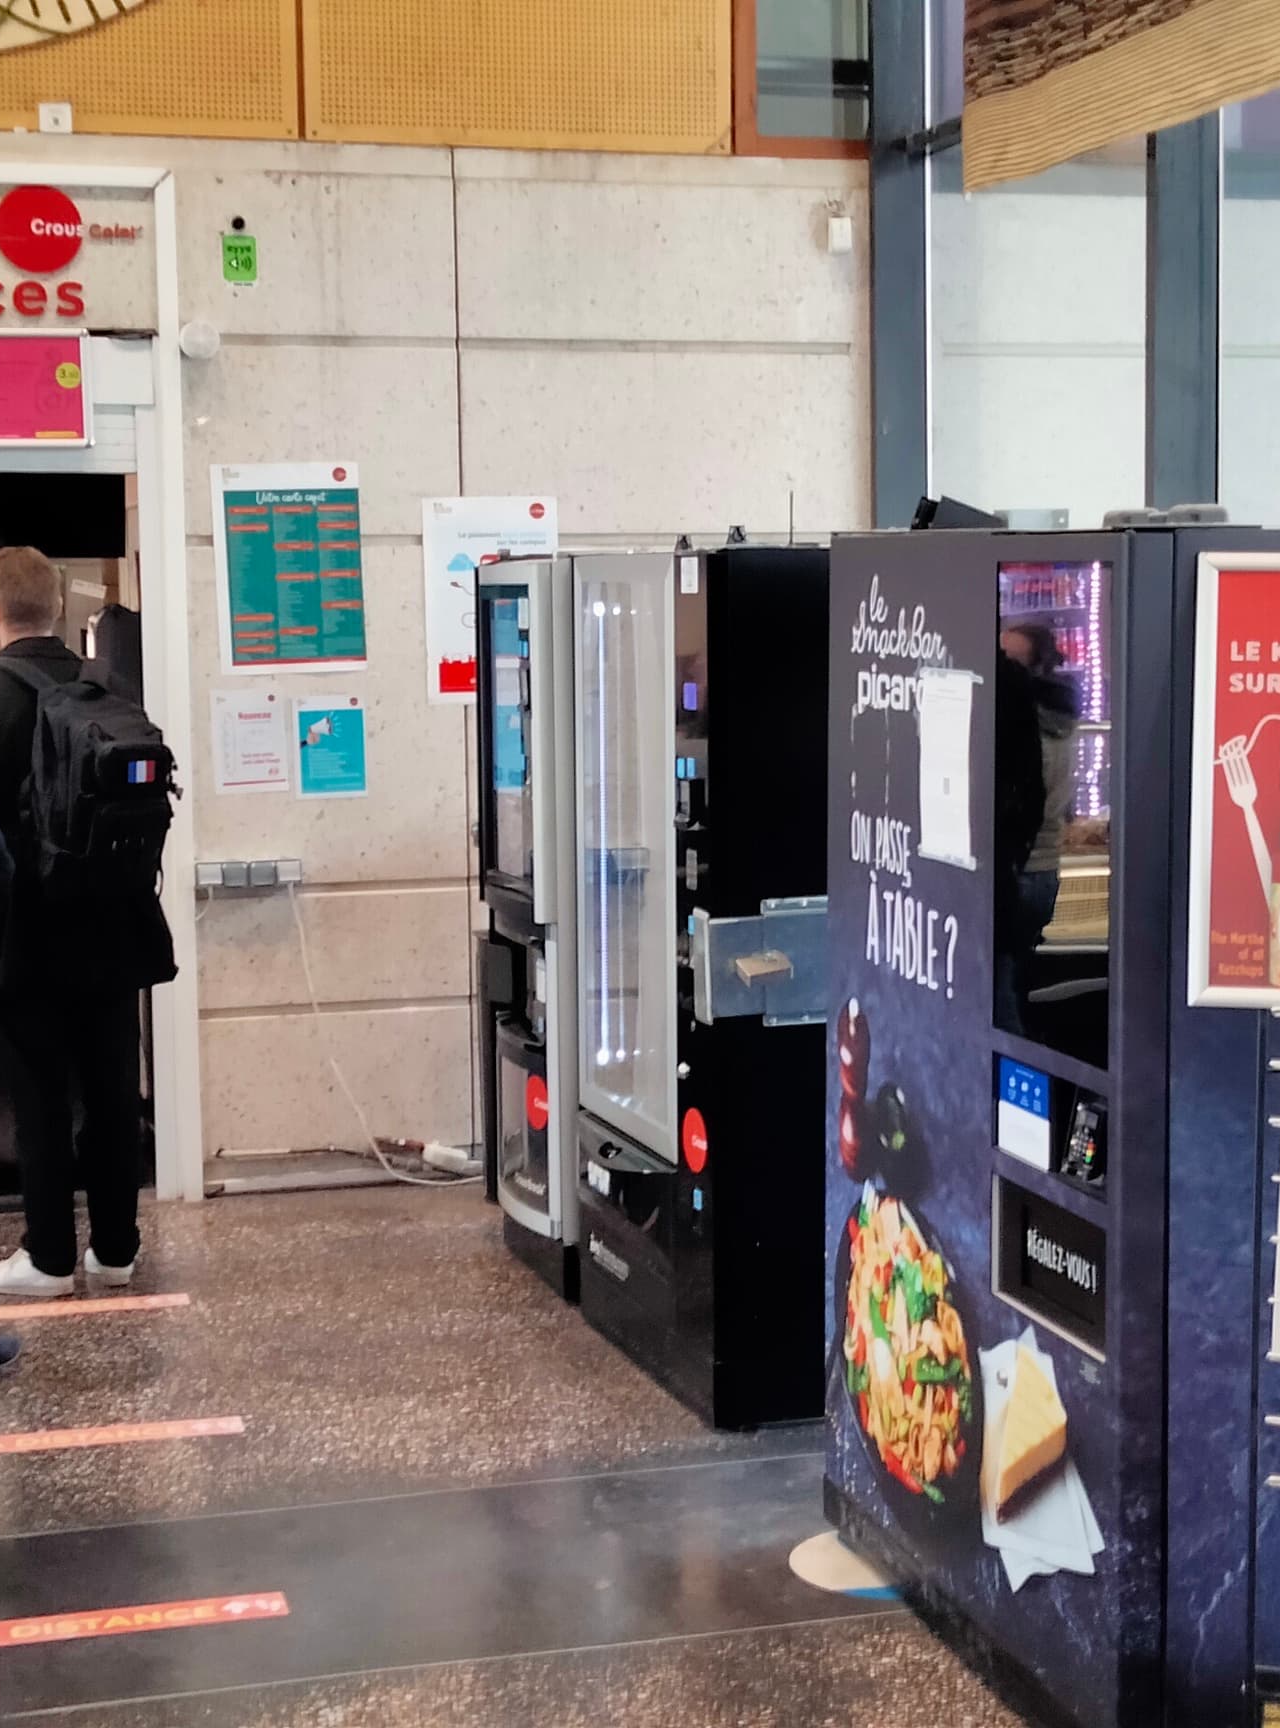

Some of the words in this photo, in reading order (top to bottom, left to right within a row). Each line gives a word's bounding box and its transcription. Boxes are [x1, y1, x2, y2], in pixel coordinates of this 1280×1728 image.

[29, 216, 86, 238] Crous
[1229, 640, 1262, 663] LE
[850, 809, 872, 865] ON
[875, 815, 912, 888] PASSE
[882, 890, 939, 991] TABLE
[9, 1604, 218, 1641] DISTANCE
